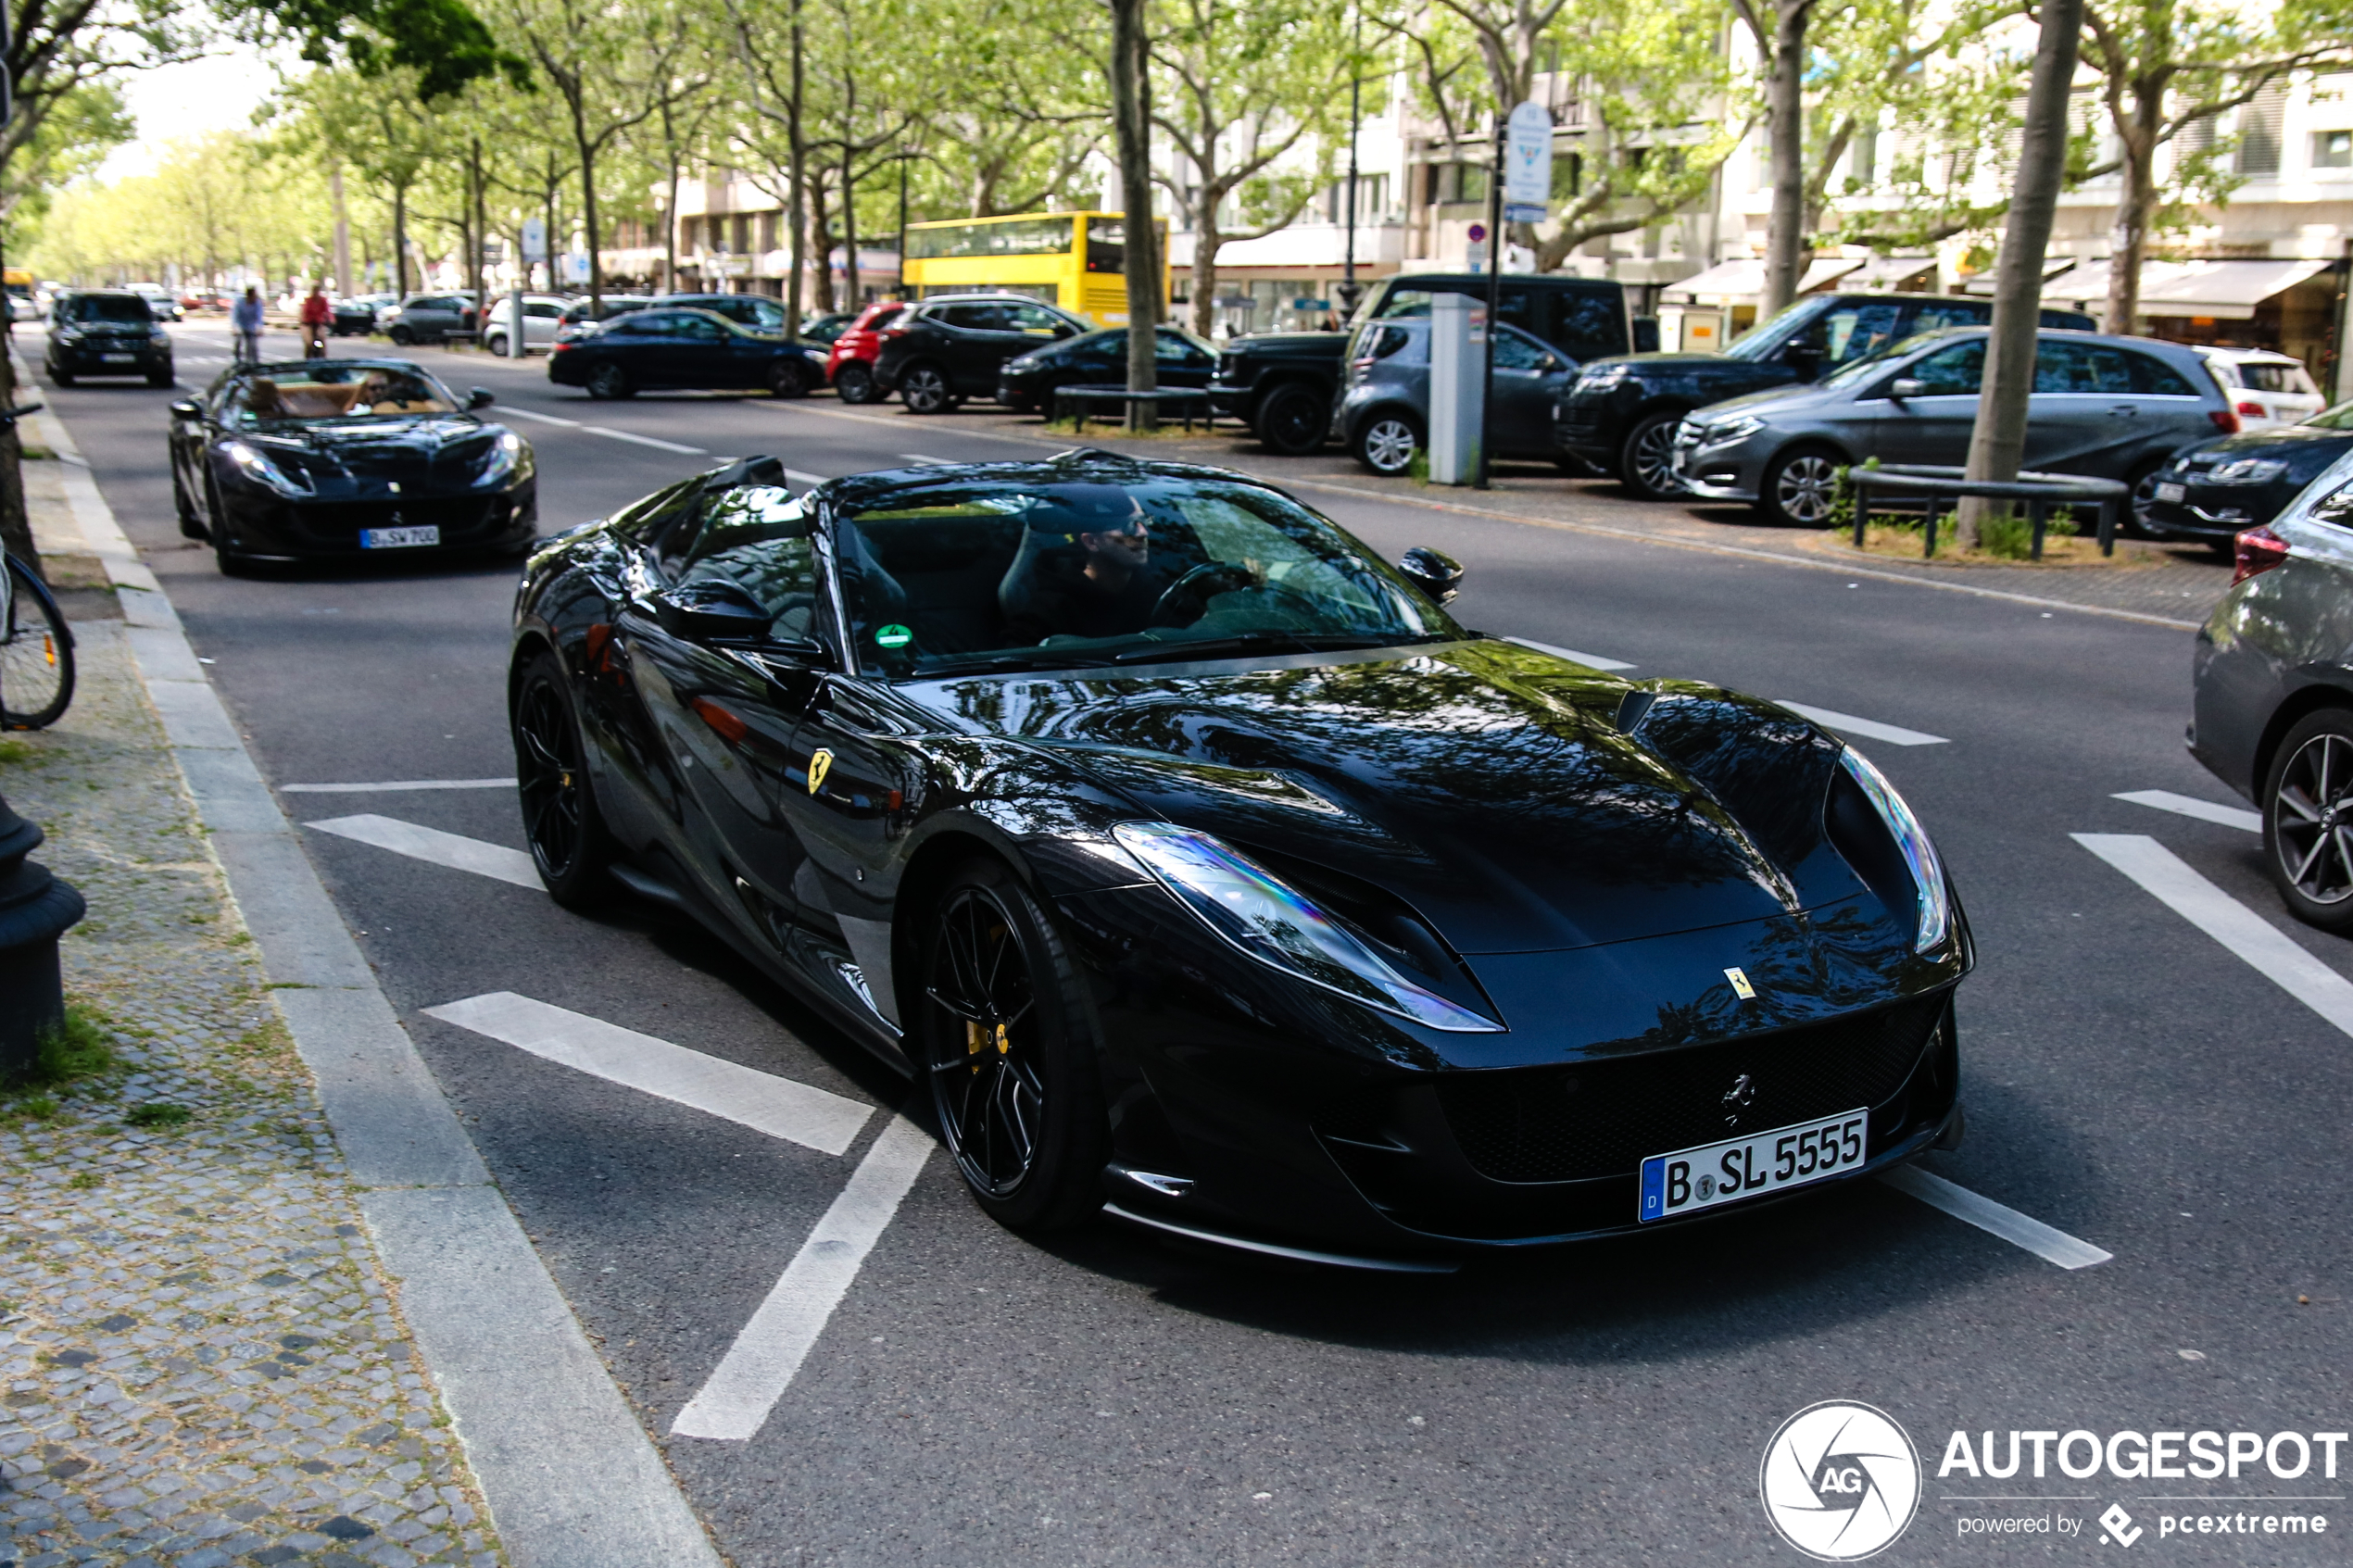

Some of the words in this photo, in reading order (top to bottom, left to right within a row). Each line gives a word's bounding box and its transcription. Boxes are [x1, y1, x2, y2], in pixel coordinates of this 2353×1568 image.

[1667, 1160, 1692, 1208] B
[1718, 1146, 1767, 1195] SL
[1775, 1118, 1863, 1181] 5555
[1648, 1195, 1656, 1209] D
